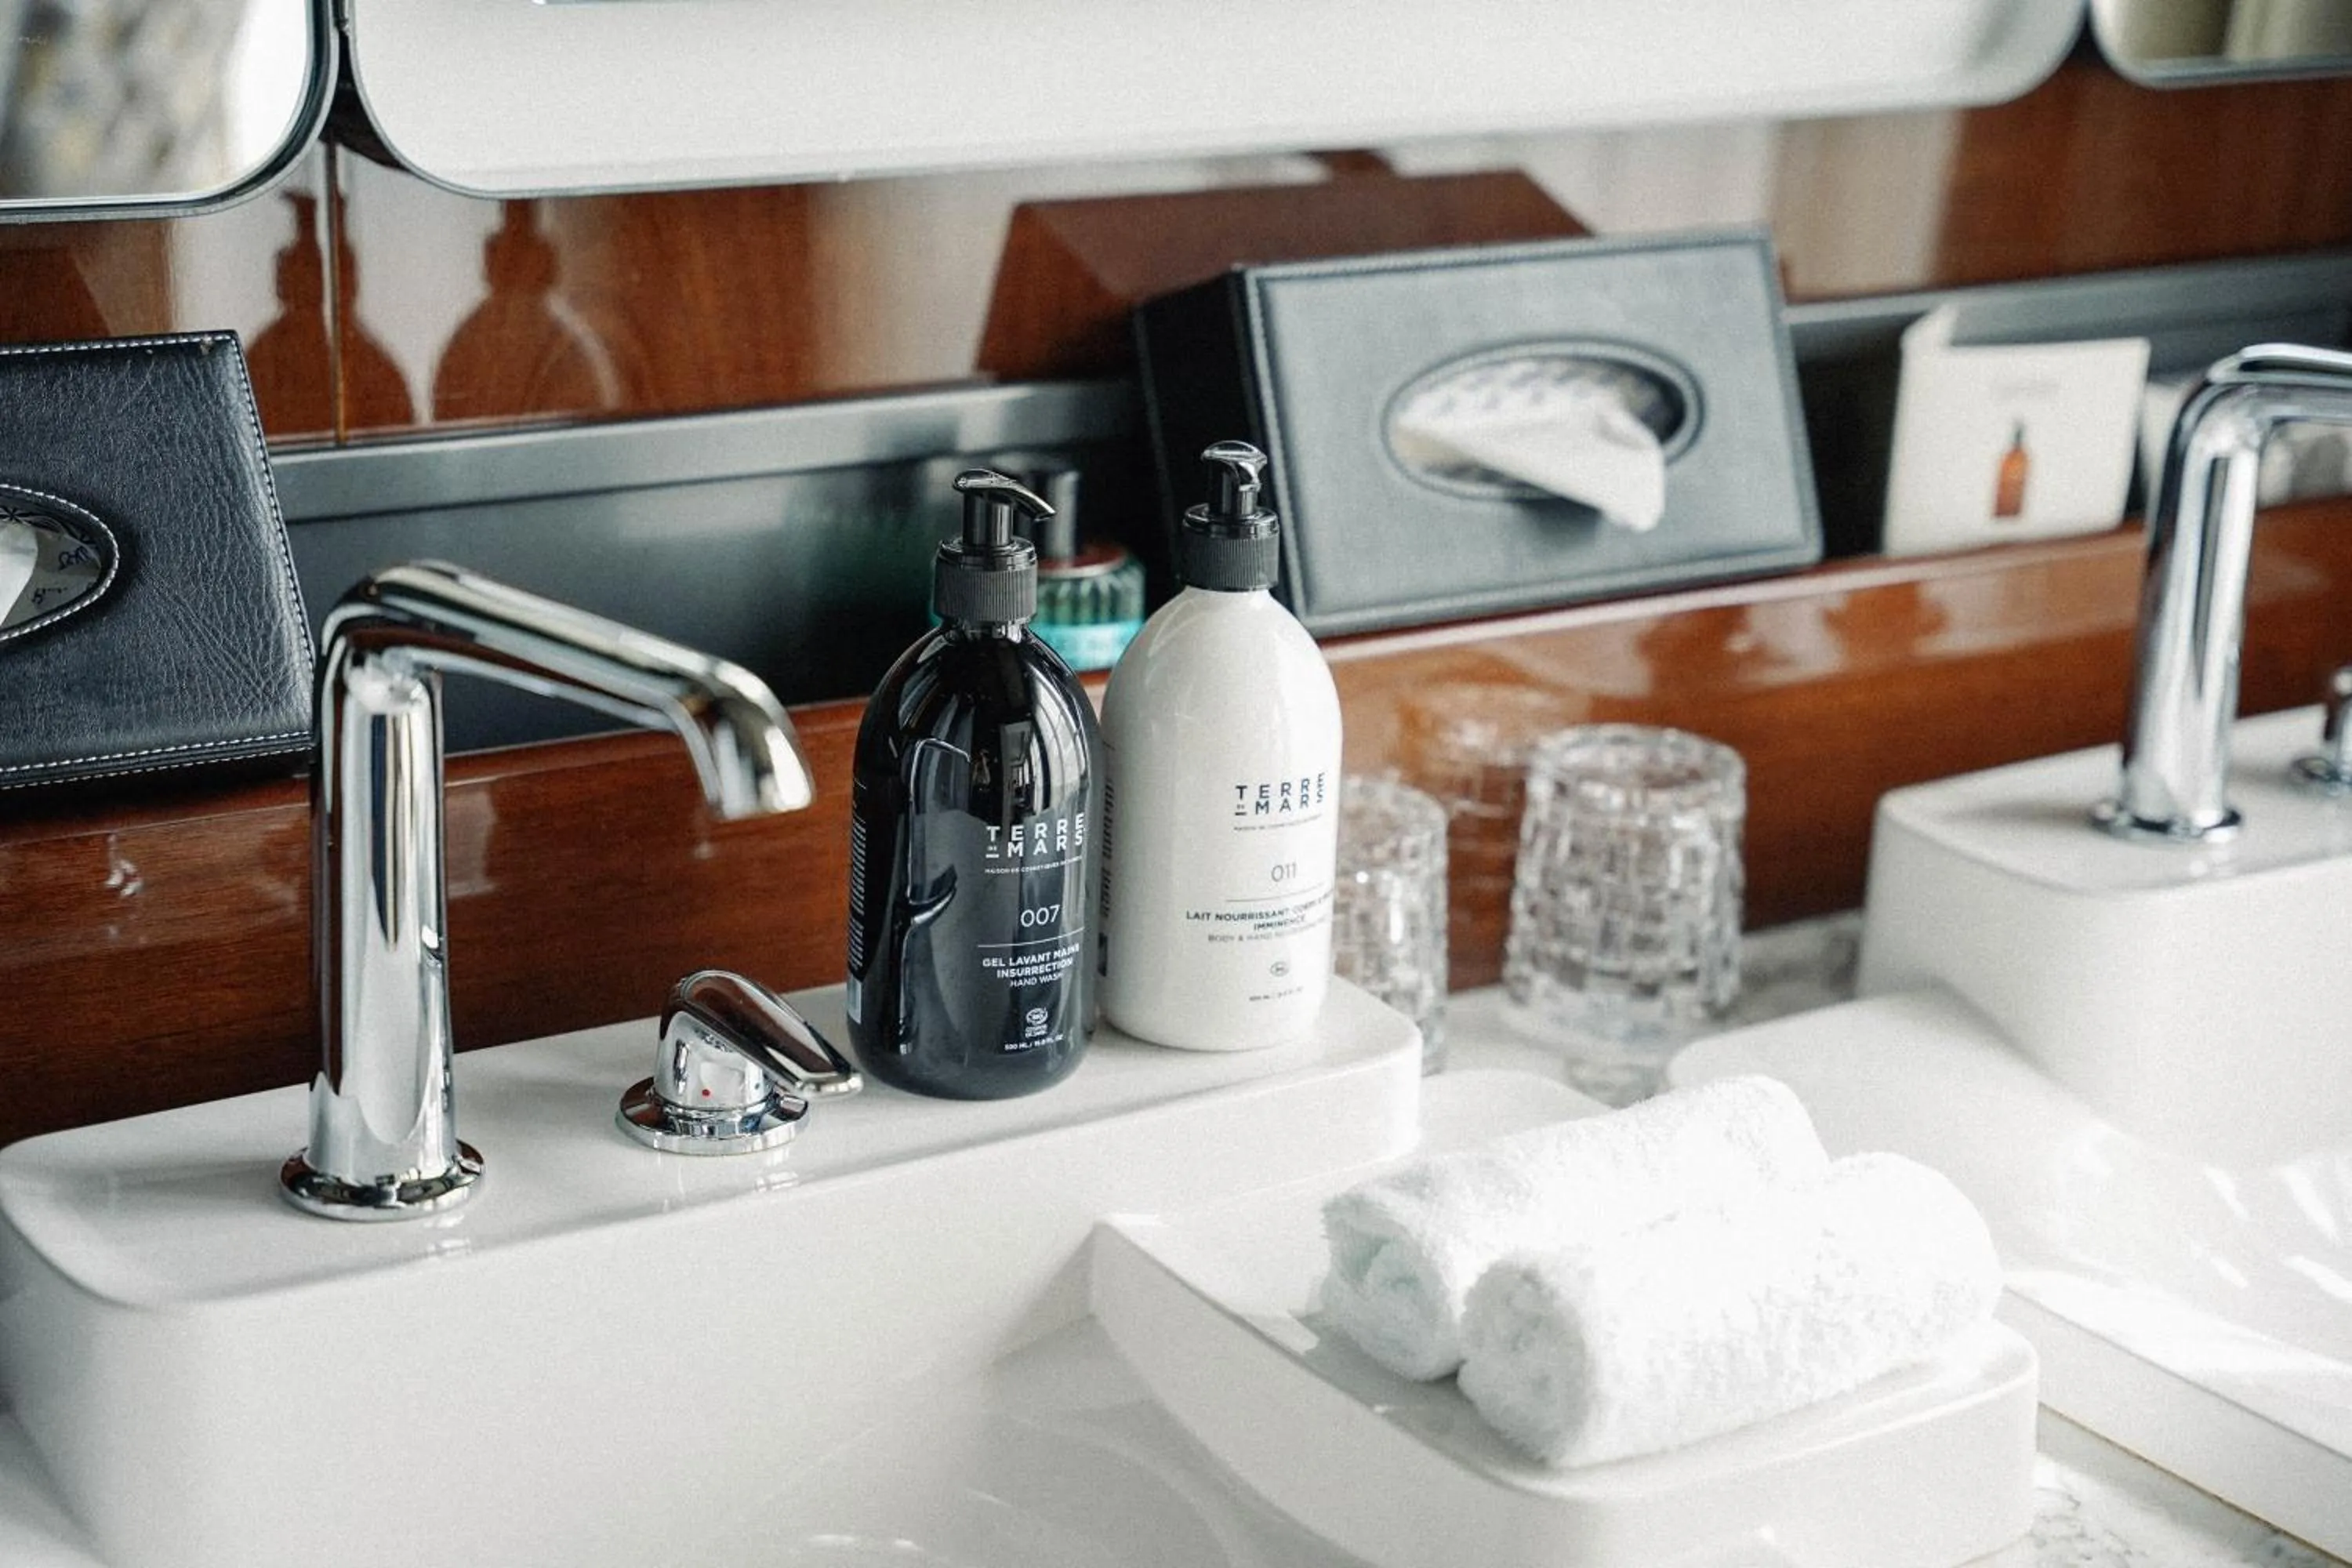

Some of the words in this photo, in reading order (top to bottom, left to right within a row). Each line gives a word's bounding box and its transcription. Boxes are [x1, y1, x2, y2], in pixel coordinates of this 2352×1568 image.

[1235, 772, 1325, 800] TERRE
[1255, 789, 1323, 815] MARS
[985, 812, 1084, 842] TERRE
[1007, 829, 1083, 858] MARS
[1271, 863, 1297, 882] 011
[1021, 904, 1060, 927] 007
[1186, 909, 1211, 920] LAIT
[982, 957, 1006, 967] GEL
[1009, 952, 1051, 966] LAVANT
[996, 957, 1073, 978] INSURRECTION
